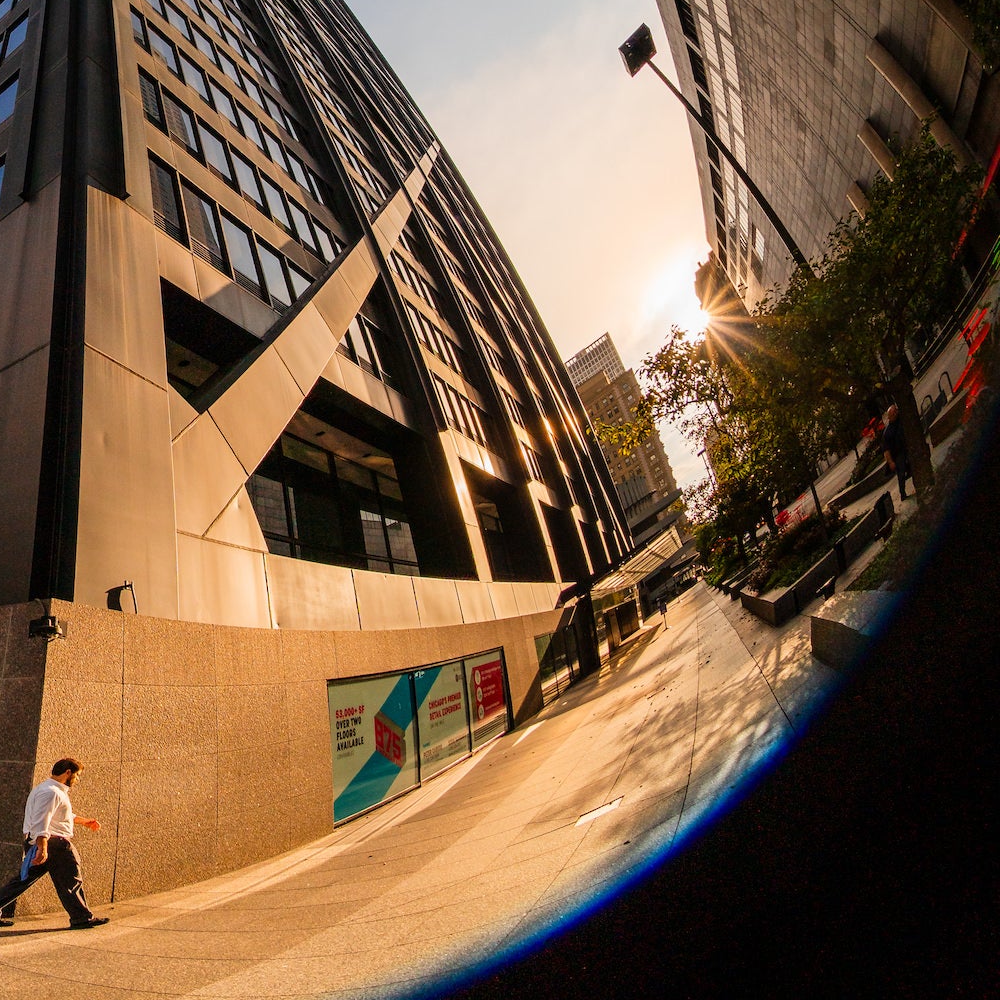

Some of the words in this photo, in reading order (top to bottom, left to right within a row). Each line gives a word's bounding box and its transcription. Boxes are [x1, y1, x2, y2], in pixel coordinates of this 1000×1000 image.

[358, 705, 365, 714] SF
[336, 719, 349, 730] OVER
[350, 716, 362, 726] TWO
[336, 728, 356, 740] FLOORS
[336, 736, 364, 751] AVAILABLE
[375, 718, 403, 766] 875
